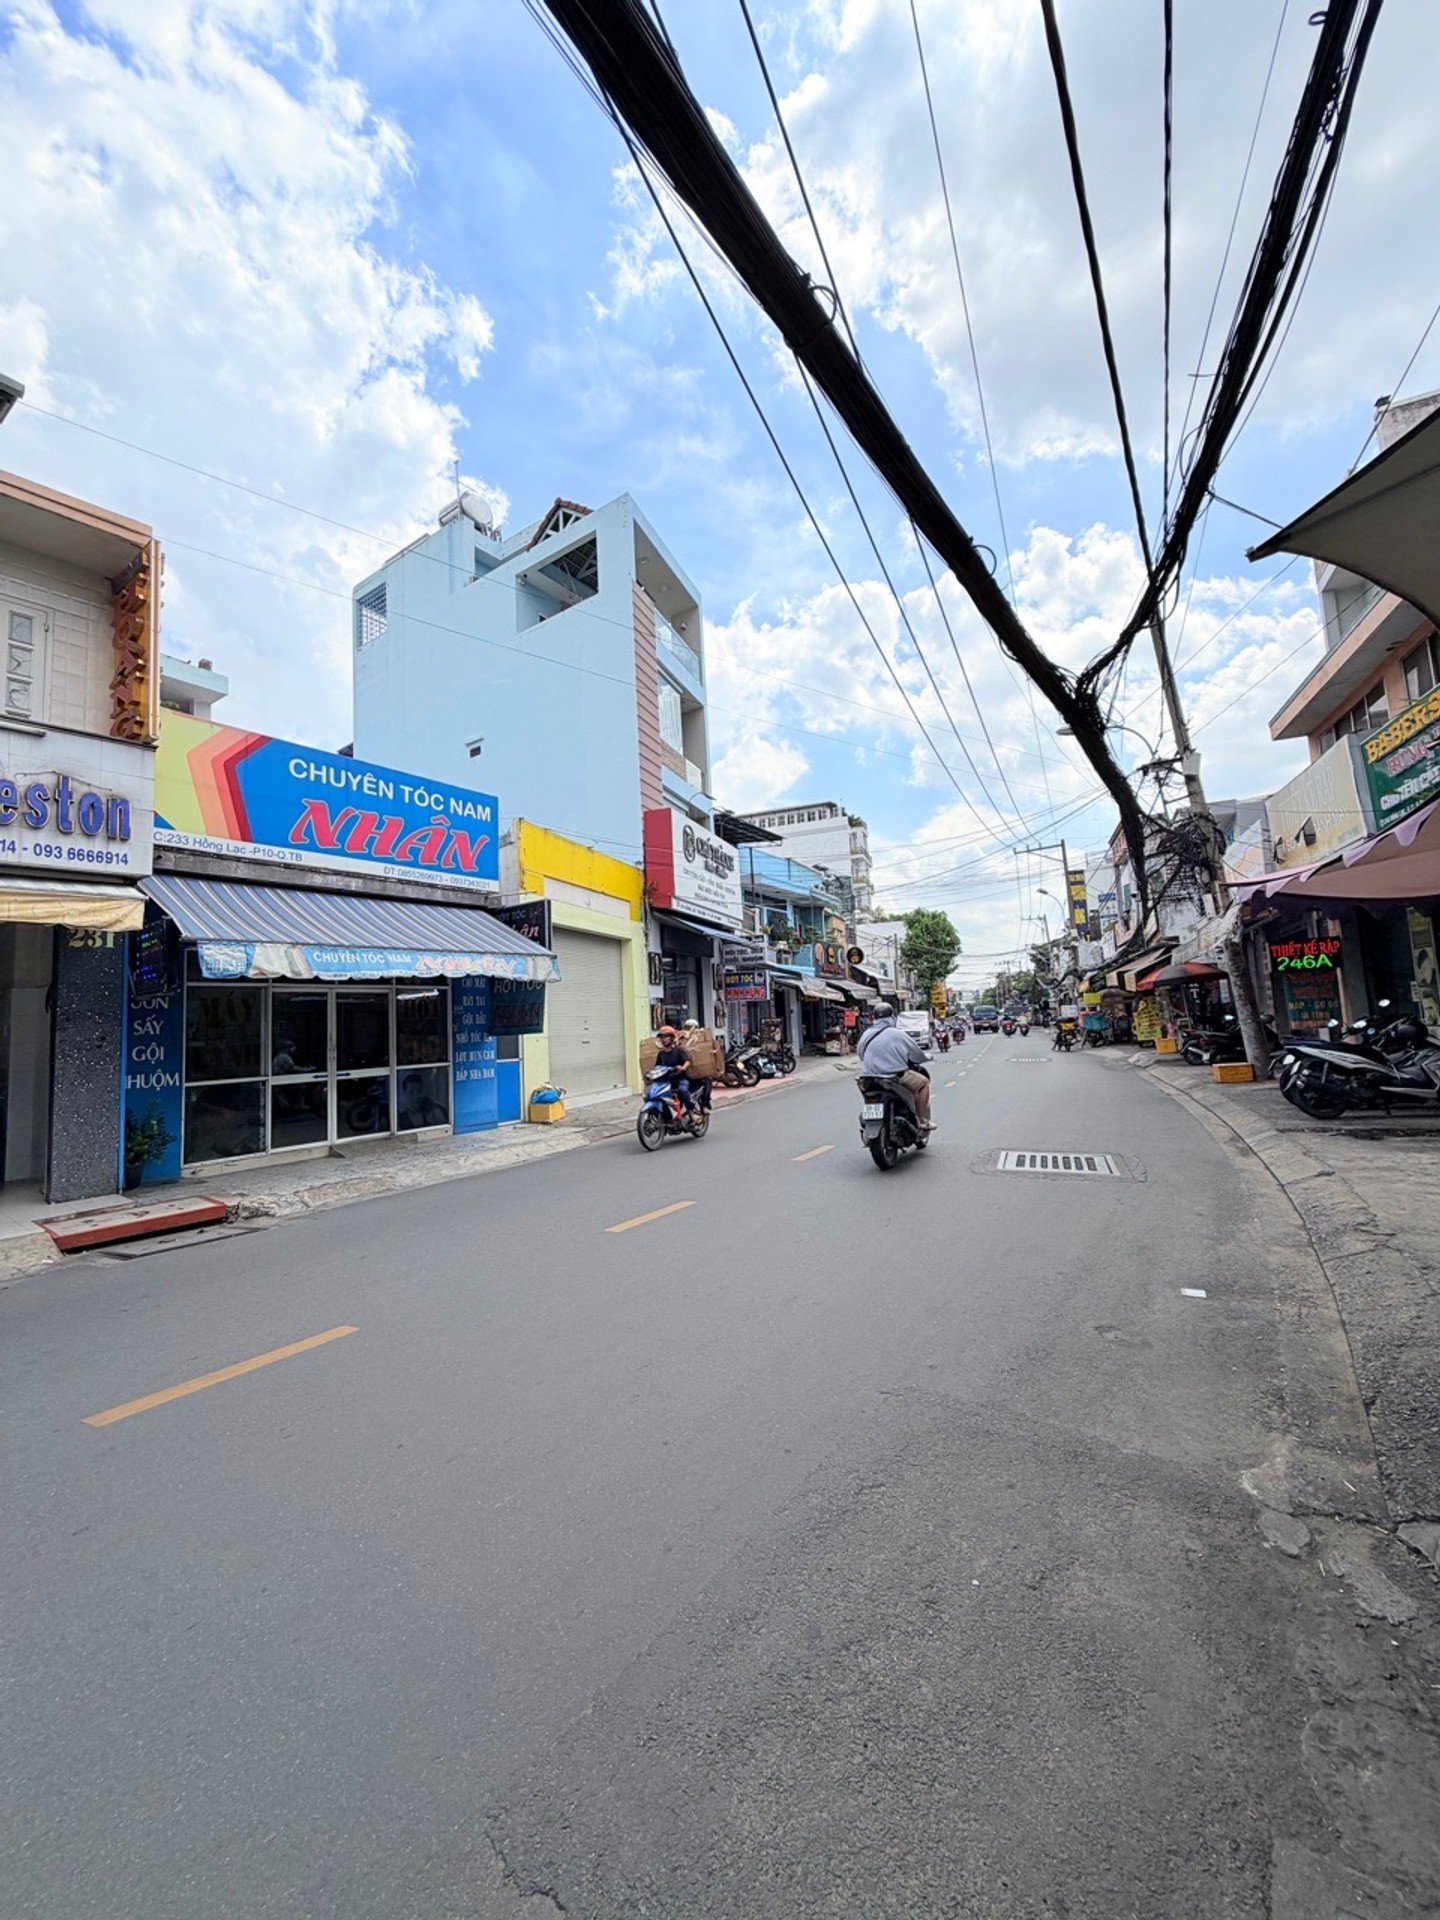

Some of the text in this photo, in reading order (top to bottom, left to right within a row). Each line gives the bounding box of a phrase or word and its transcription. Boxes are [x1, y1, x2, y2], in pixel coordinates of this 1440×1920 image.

[289, 757, 491, 822] CHUYÊN TÓC NAM
[289, 799, 489, 873] NHÂN
[33, 842, 63, 860] 093
[67, 847, 129, 866] 6666914
[313, 950, 360, 963] CHUYÊN
[363, 951, 385, 964] TÓC
[1277, 954, 1333, 971] 246A
[133, 1014, 164, 1035] SẤY
[132, 1042, 165, 1065] GỘI
